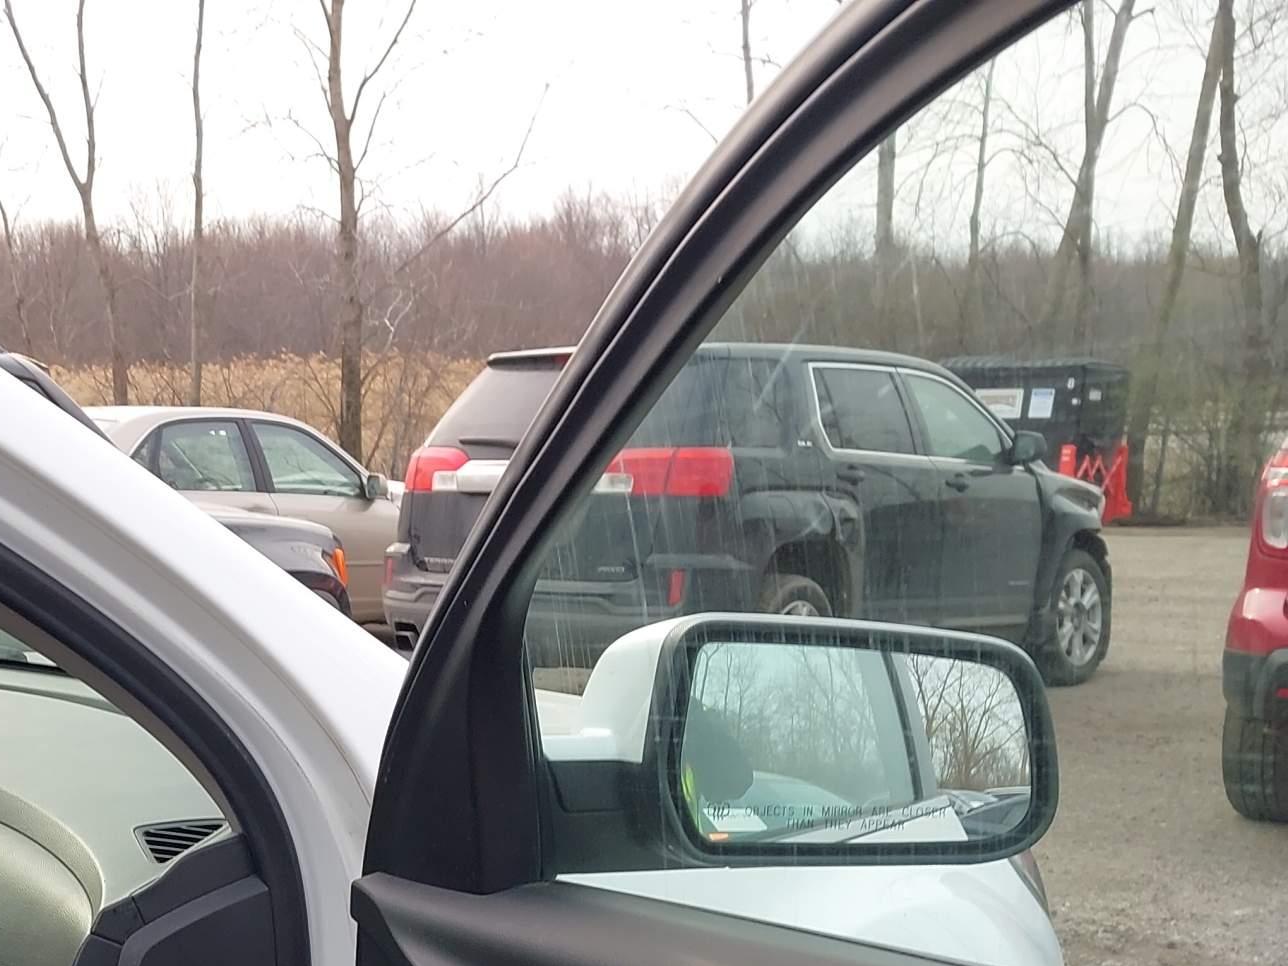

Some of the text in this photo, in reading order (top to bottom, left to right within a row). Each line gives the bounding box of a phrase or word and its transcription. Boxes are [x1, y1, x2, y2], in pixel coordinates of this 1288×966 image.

[744, 805, 947, 819] OBJECTS IN MIRROR ARE CLOSER
[786, 818, 905, 831] THAN THEY APPEAR
